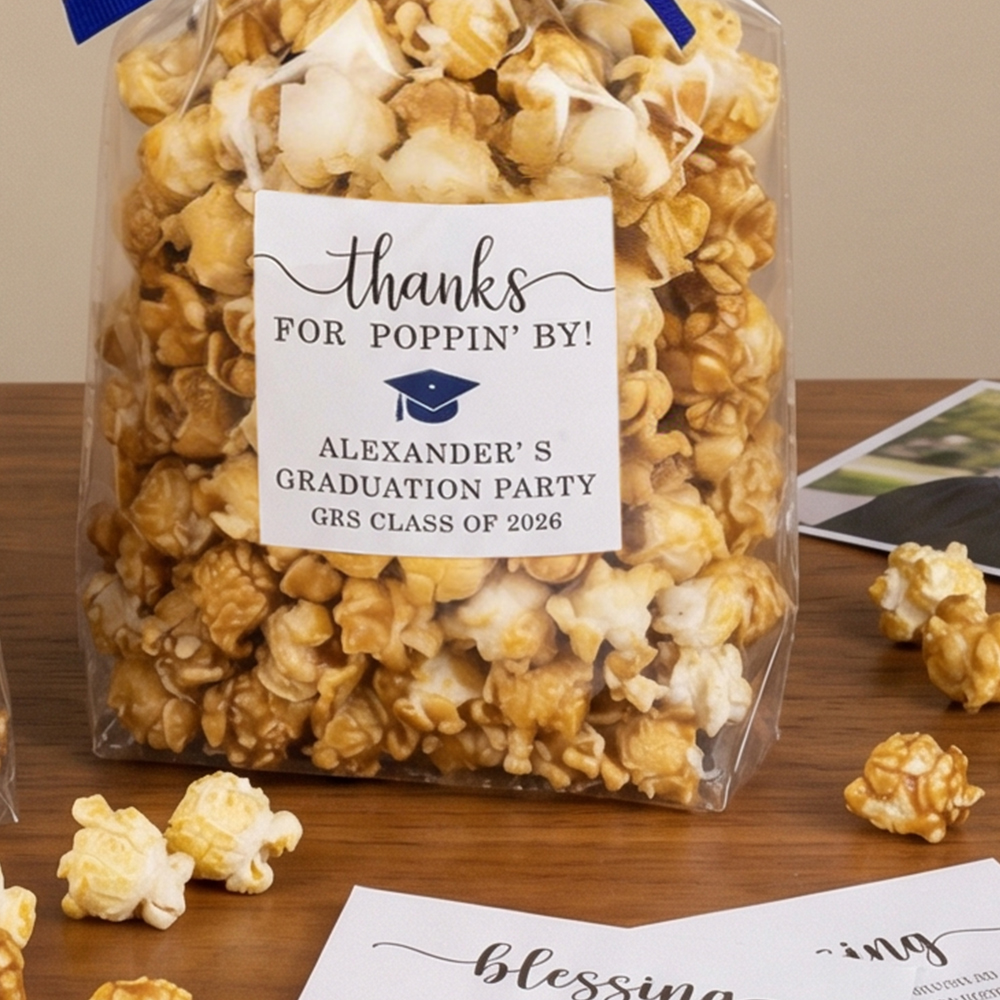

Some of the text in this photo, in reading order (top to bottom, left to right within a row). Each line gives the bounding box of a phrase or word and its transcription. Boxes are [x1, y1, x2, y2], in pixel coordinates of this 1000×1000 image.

[254, 232, 615, 313] thanks
[274, 317, 592, 351] FOR POPPIN' BY!
[276, 468, 596, 499] GRADUATION PARTY
[312, 508, 562, 532] GRS CLASS OF 2026
